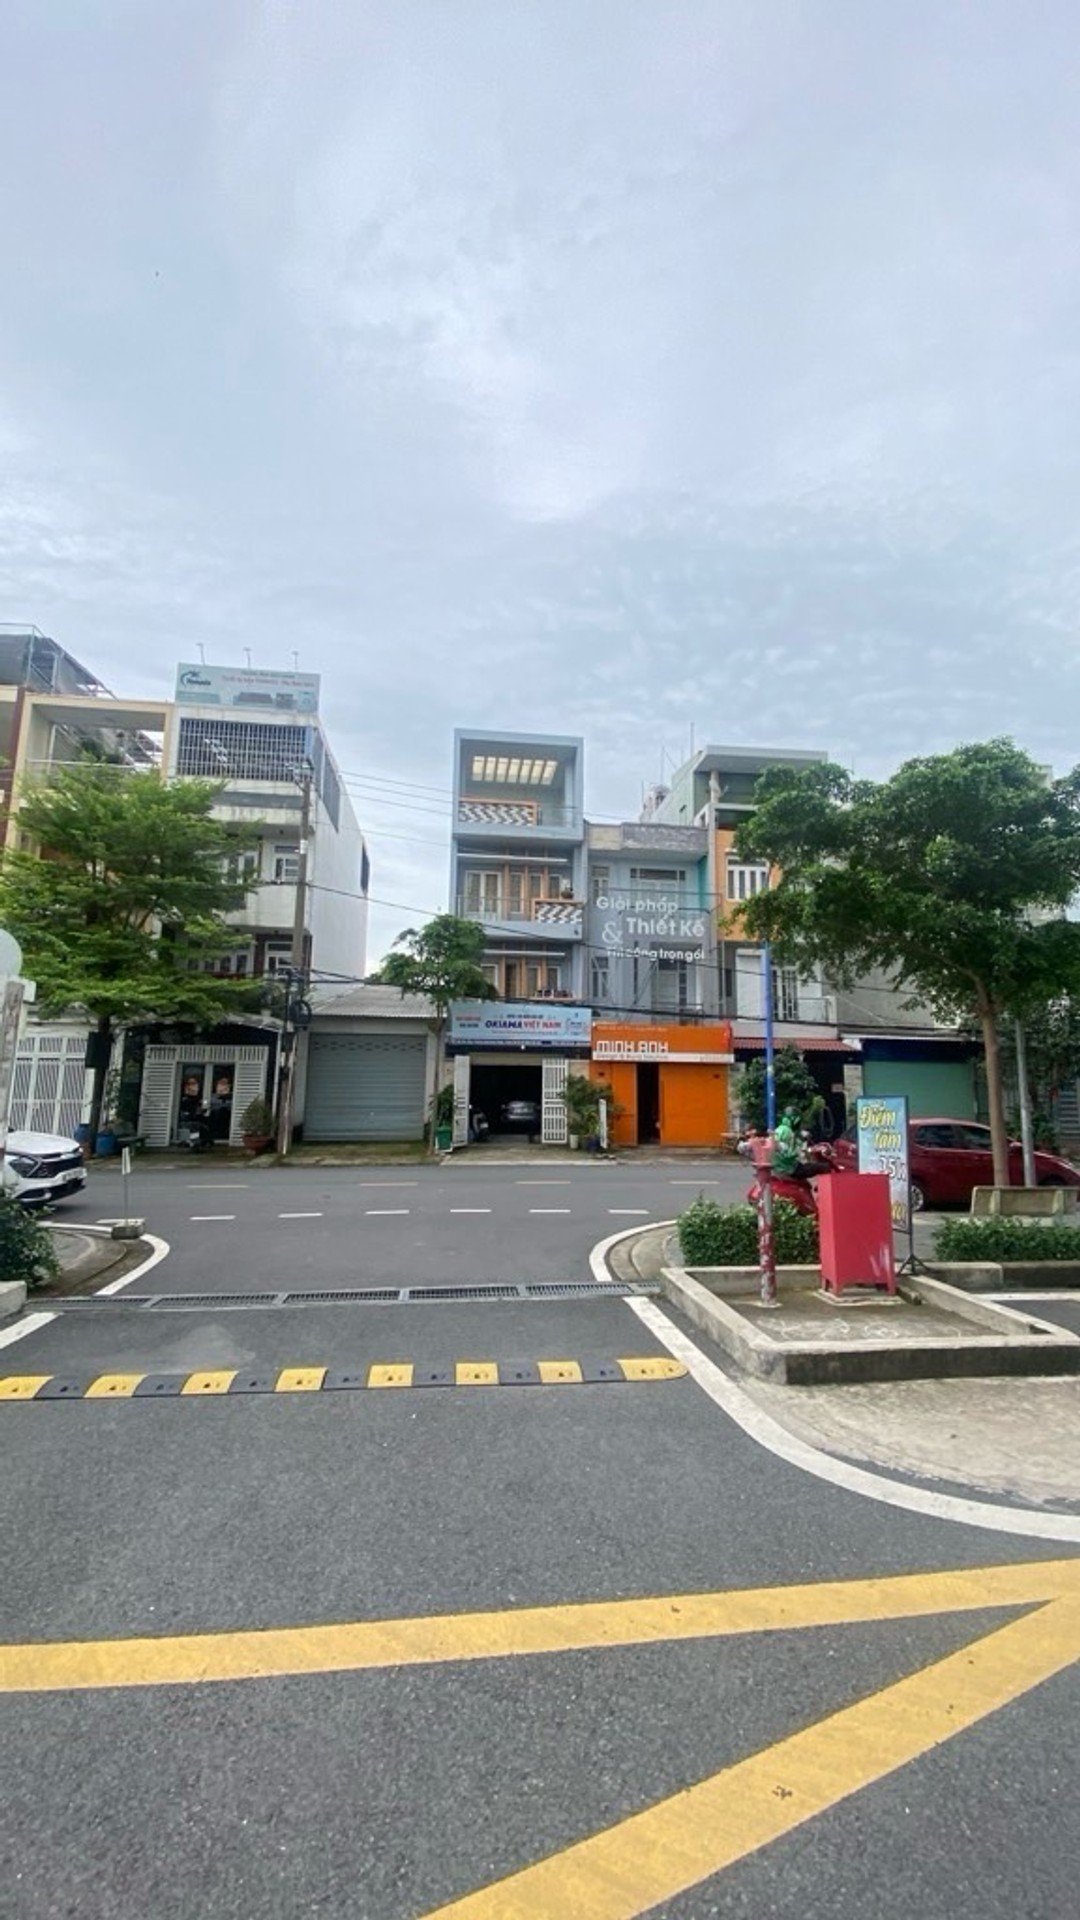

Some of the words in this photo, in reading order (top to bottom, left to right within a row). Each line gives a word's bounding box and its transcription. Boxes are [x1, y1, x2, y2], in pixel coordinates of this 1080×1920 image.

[596, 896, 630, 911] Giải
[635, 897, 679, 914] pháp
[602, 921, 624, 945] &
[626, 914, 677, 937] Thiết
[680, 917, 706, 938] Kế
[660, 948, 683, 964] trọn
[684, 949, 705, 963] gói
[861, 1101, 896, 1128] Điểm
